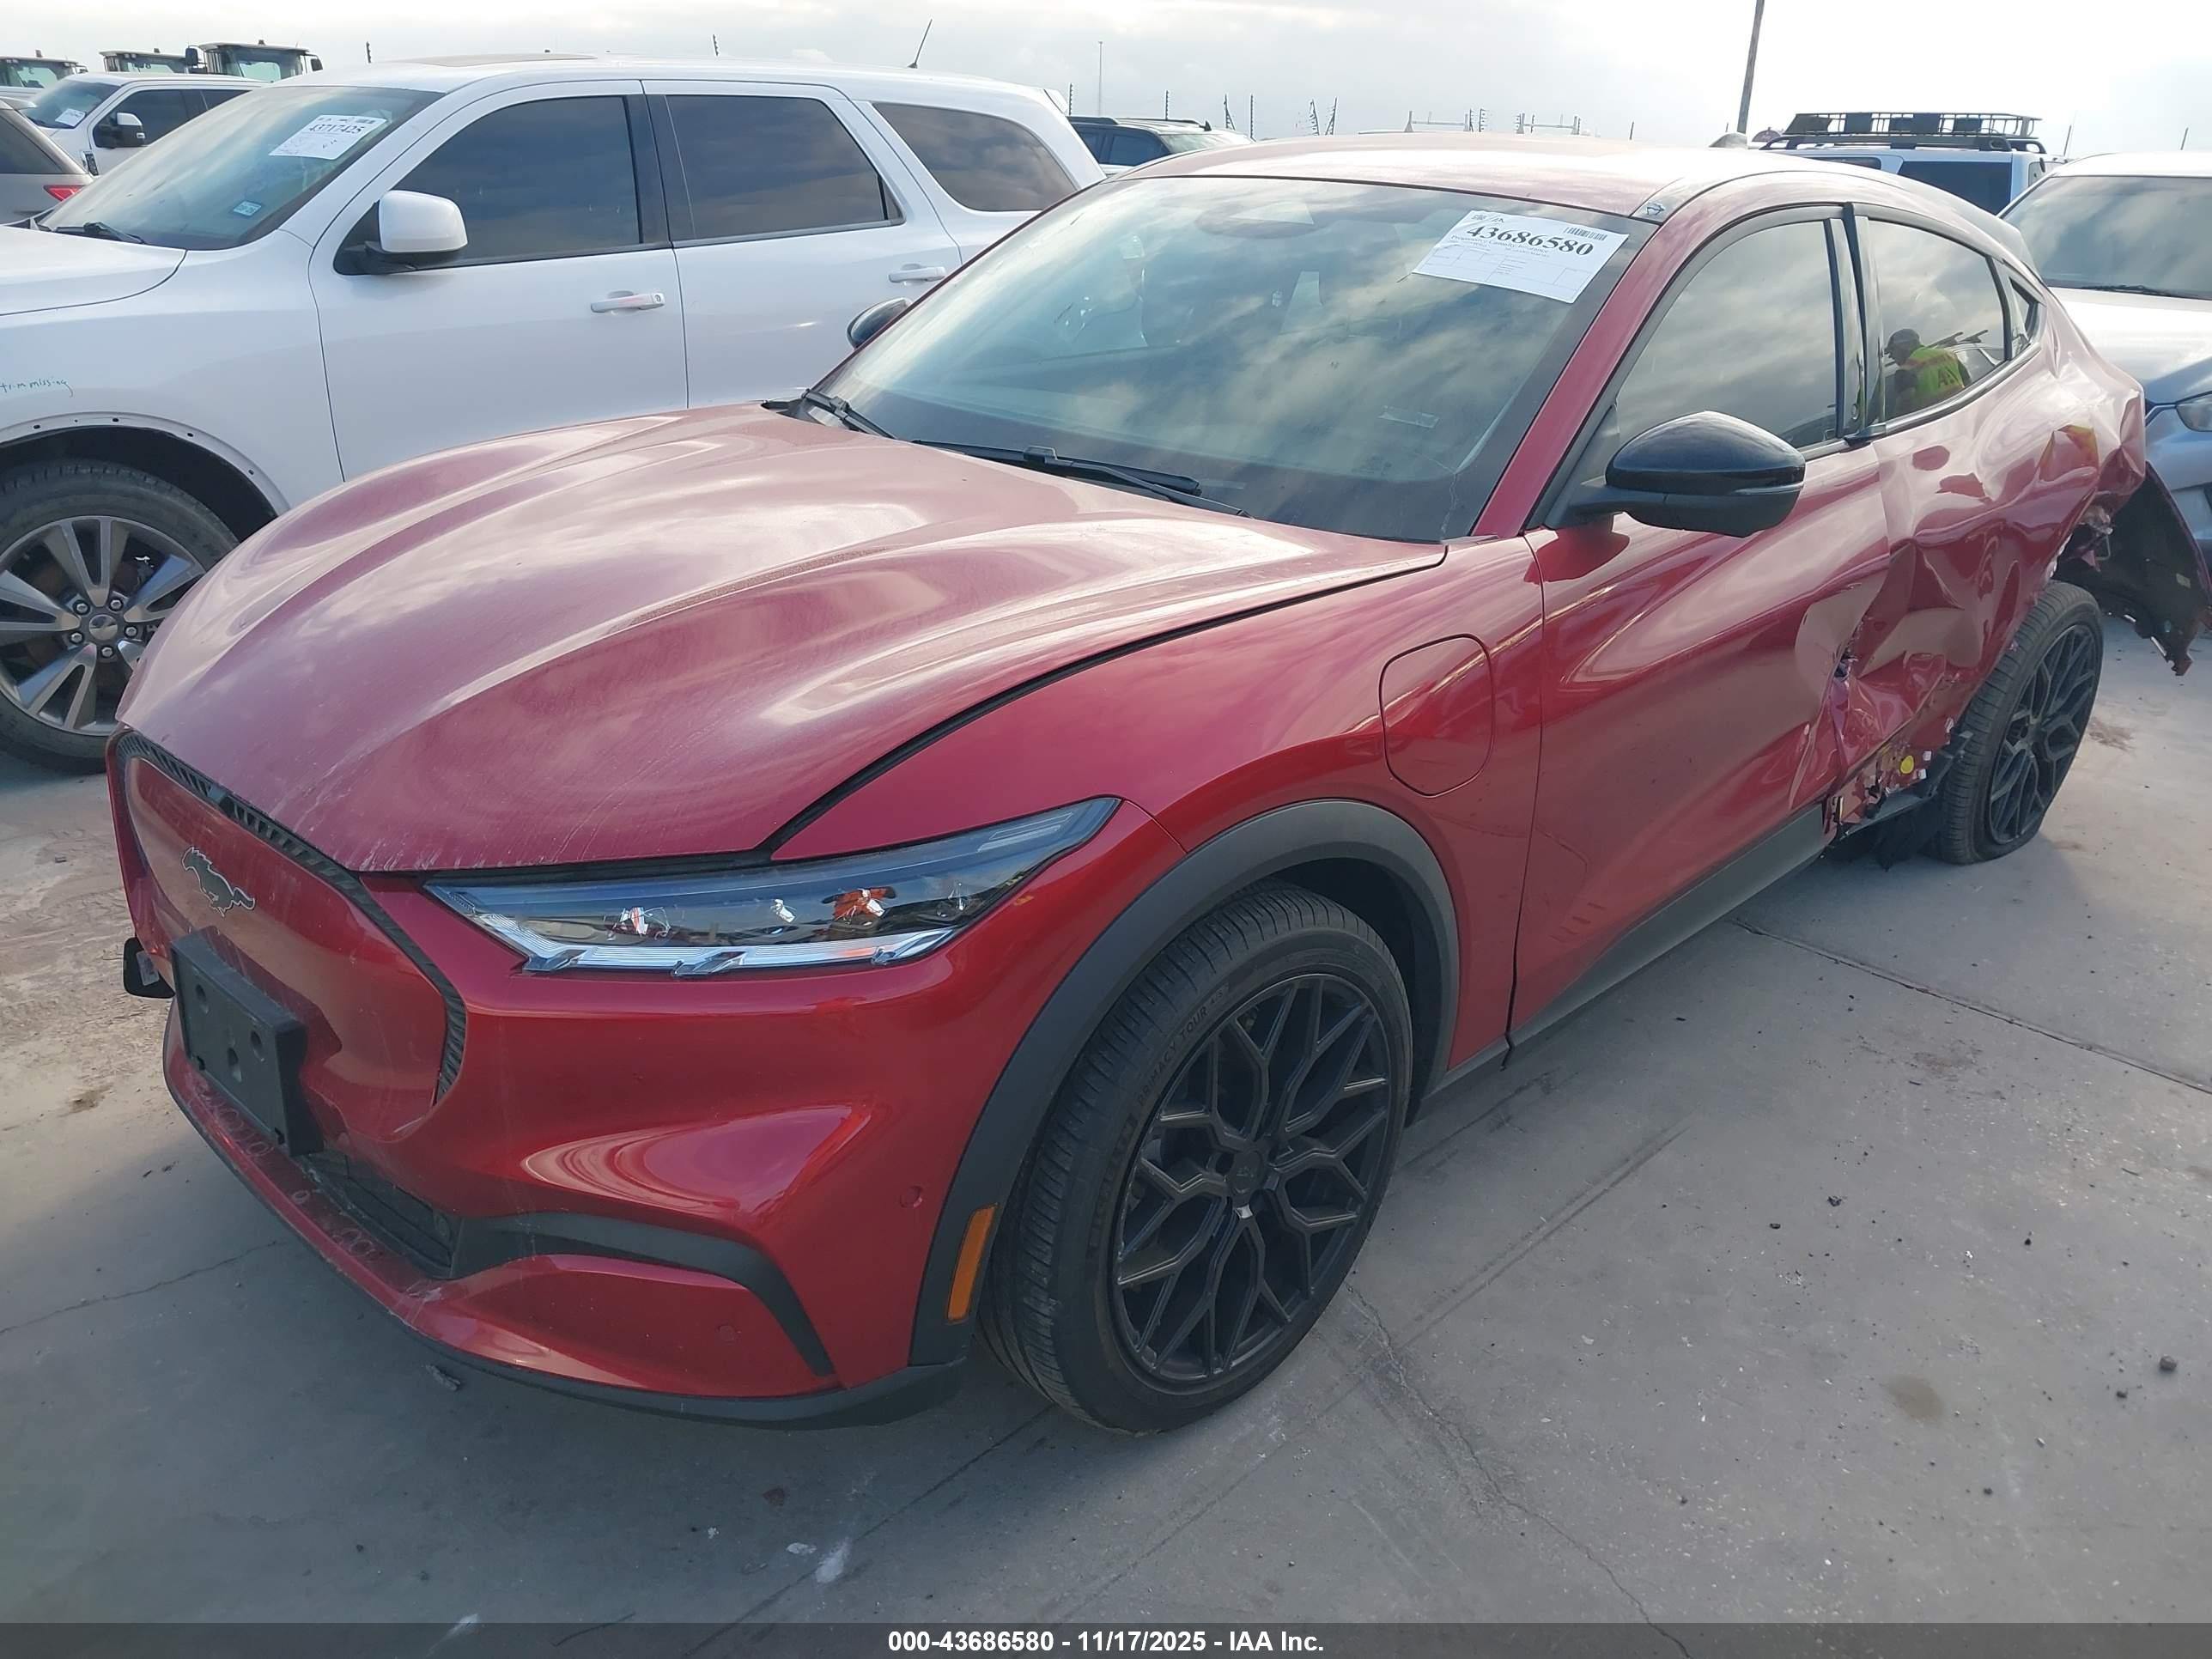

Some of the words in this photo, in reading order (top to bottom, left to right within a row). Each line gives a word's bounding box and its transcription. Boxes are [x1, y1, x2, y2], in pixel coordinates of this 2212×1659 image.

[309, 124, 365, 134] 43717425
[1467, 225, 1594, 256] 43686580
[1138, 1041, 1177, 1107] PRIMACY
[1180, 1006, 1208, 1039] TOUR
